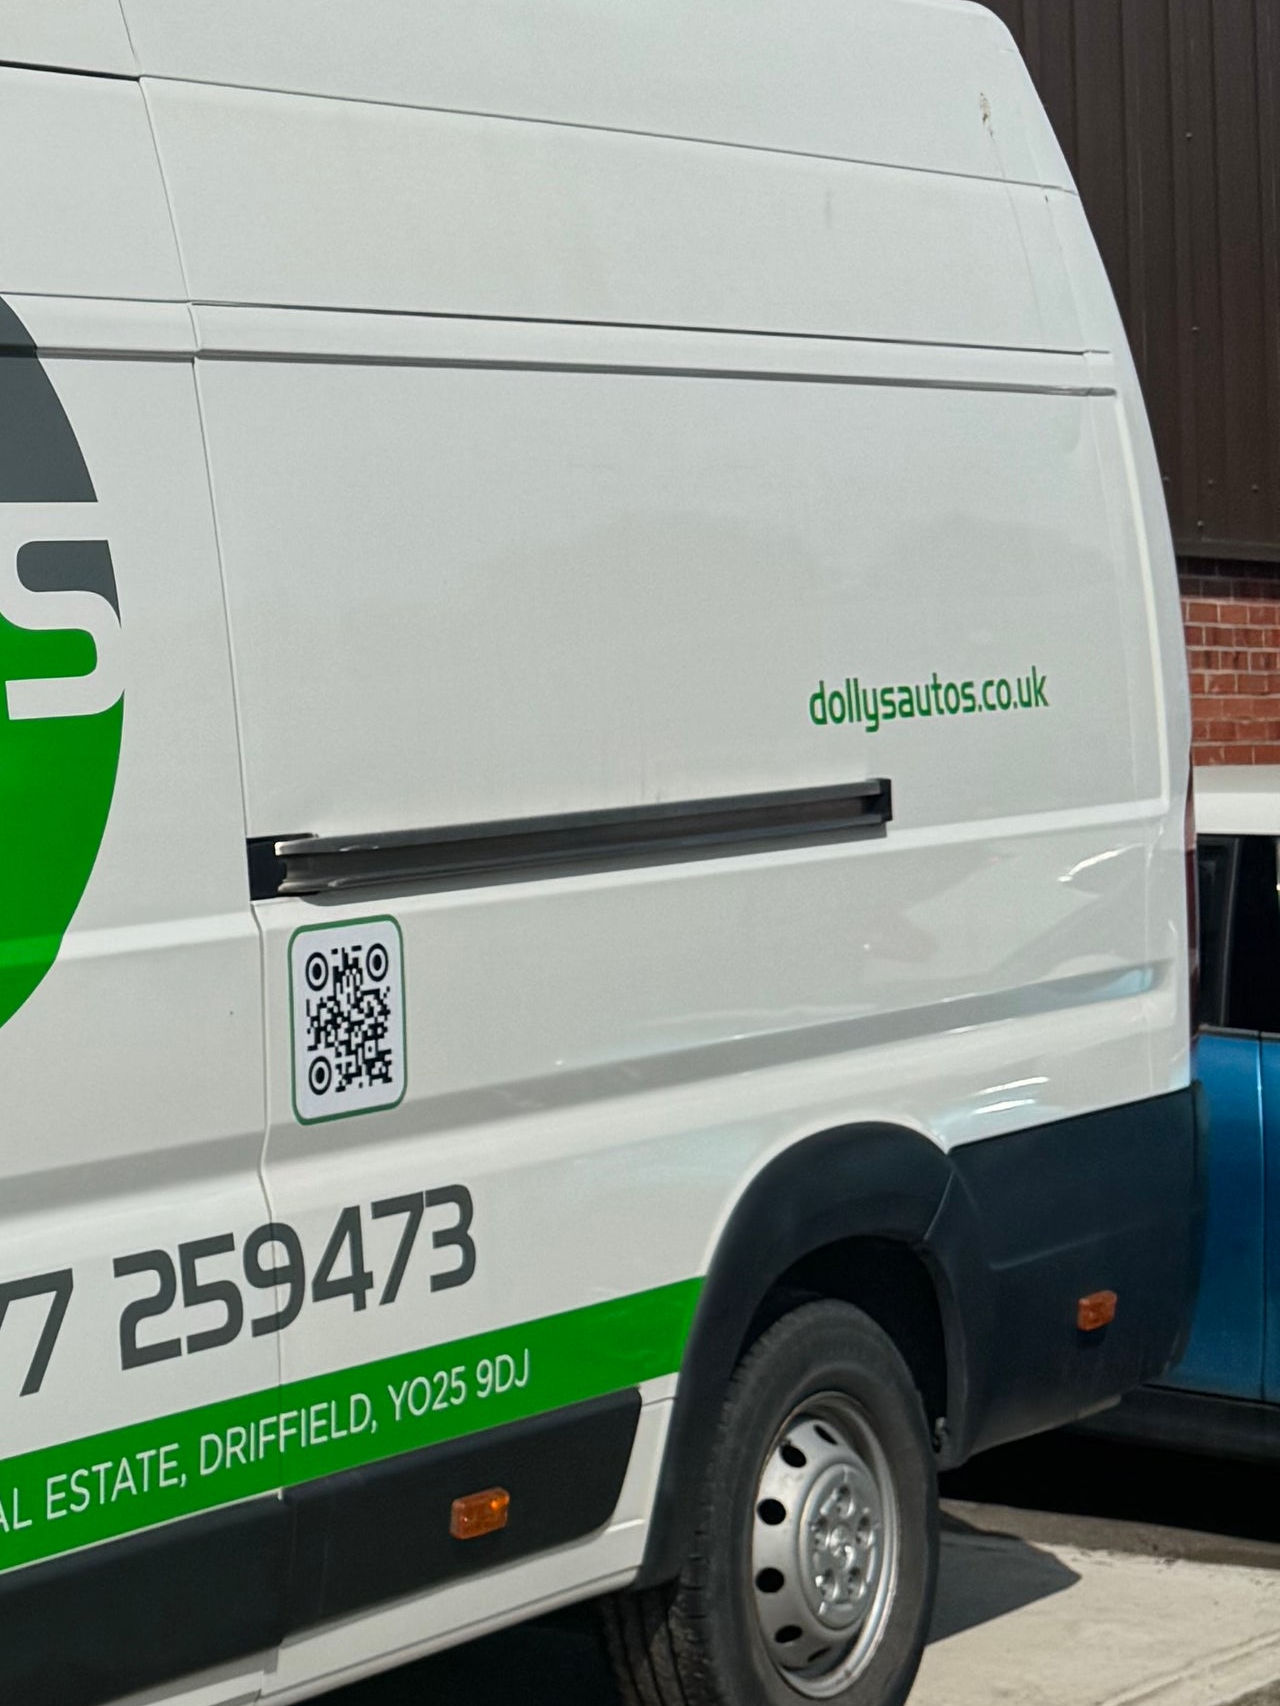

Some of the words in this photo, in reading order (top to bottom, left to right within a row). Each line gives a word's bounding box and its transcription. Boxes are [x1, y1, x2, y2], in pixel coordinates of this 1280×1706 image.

[808, 665, 1050, 734] dollysautos.co.uk
[112, 1183, 478, 1372] 259473
[45, 1443, 188, 1521] ESTATE,
[198, 1392, 378, 1477] DRIFFIELD,
[386, 1365, 467, 1422] YO25
[475, 1348, 530, 1399] 9DJ
